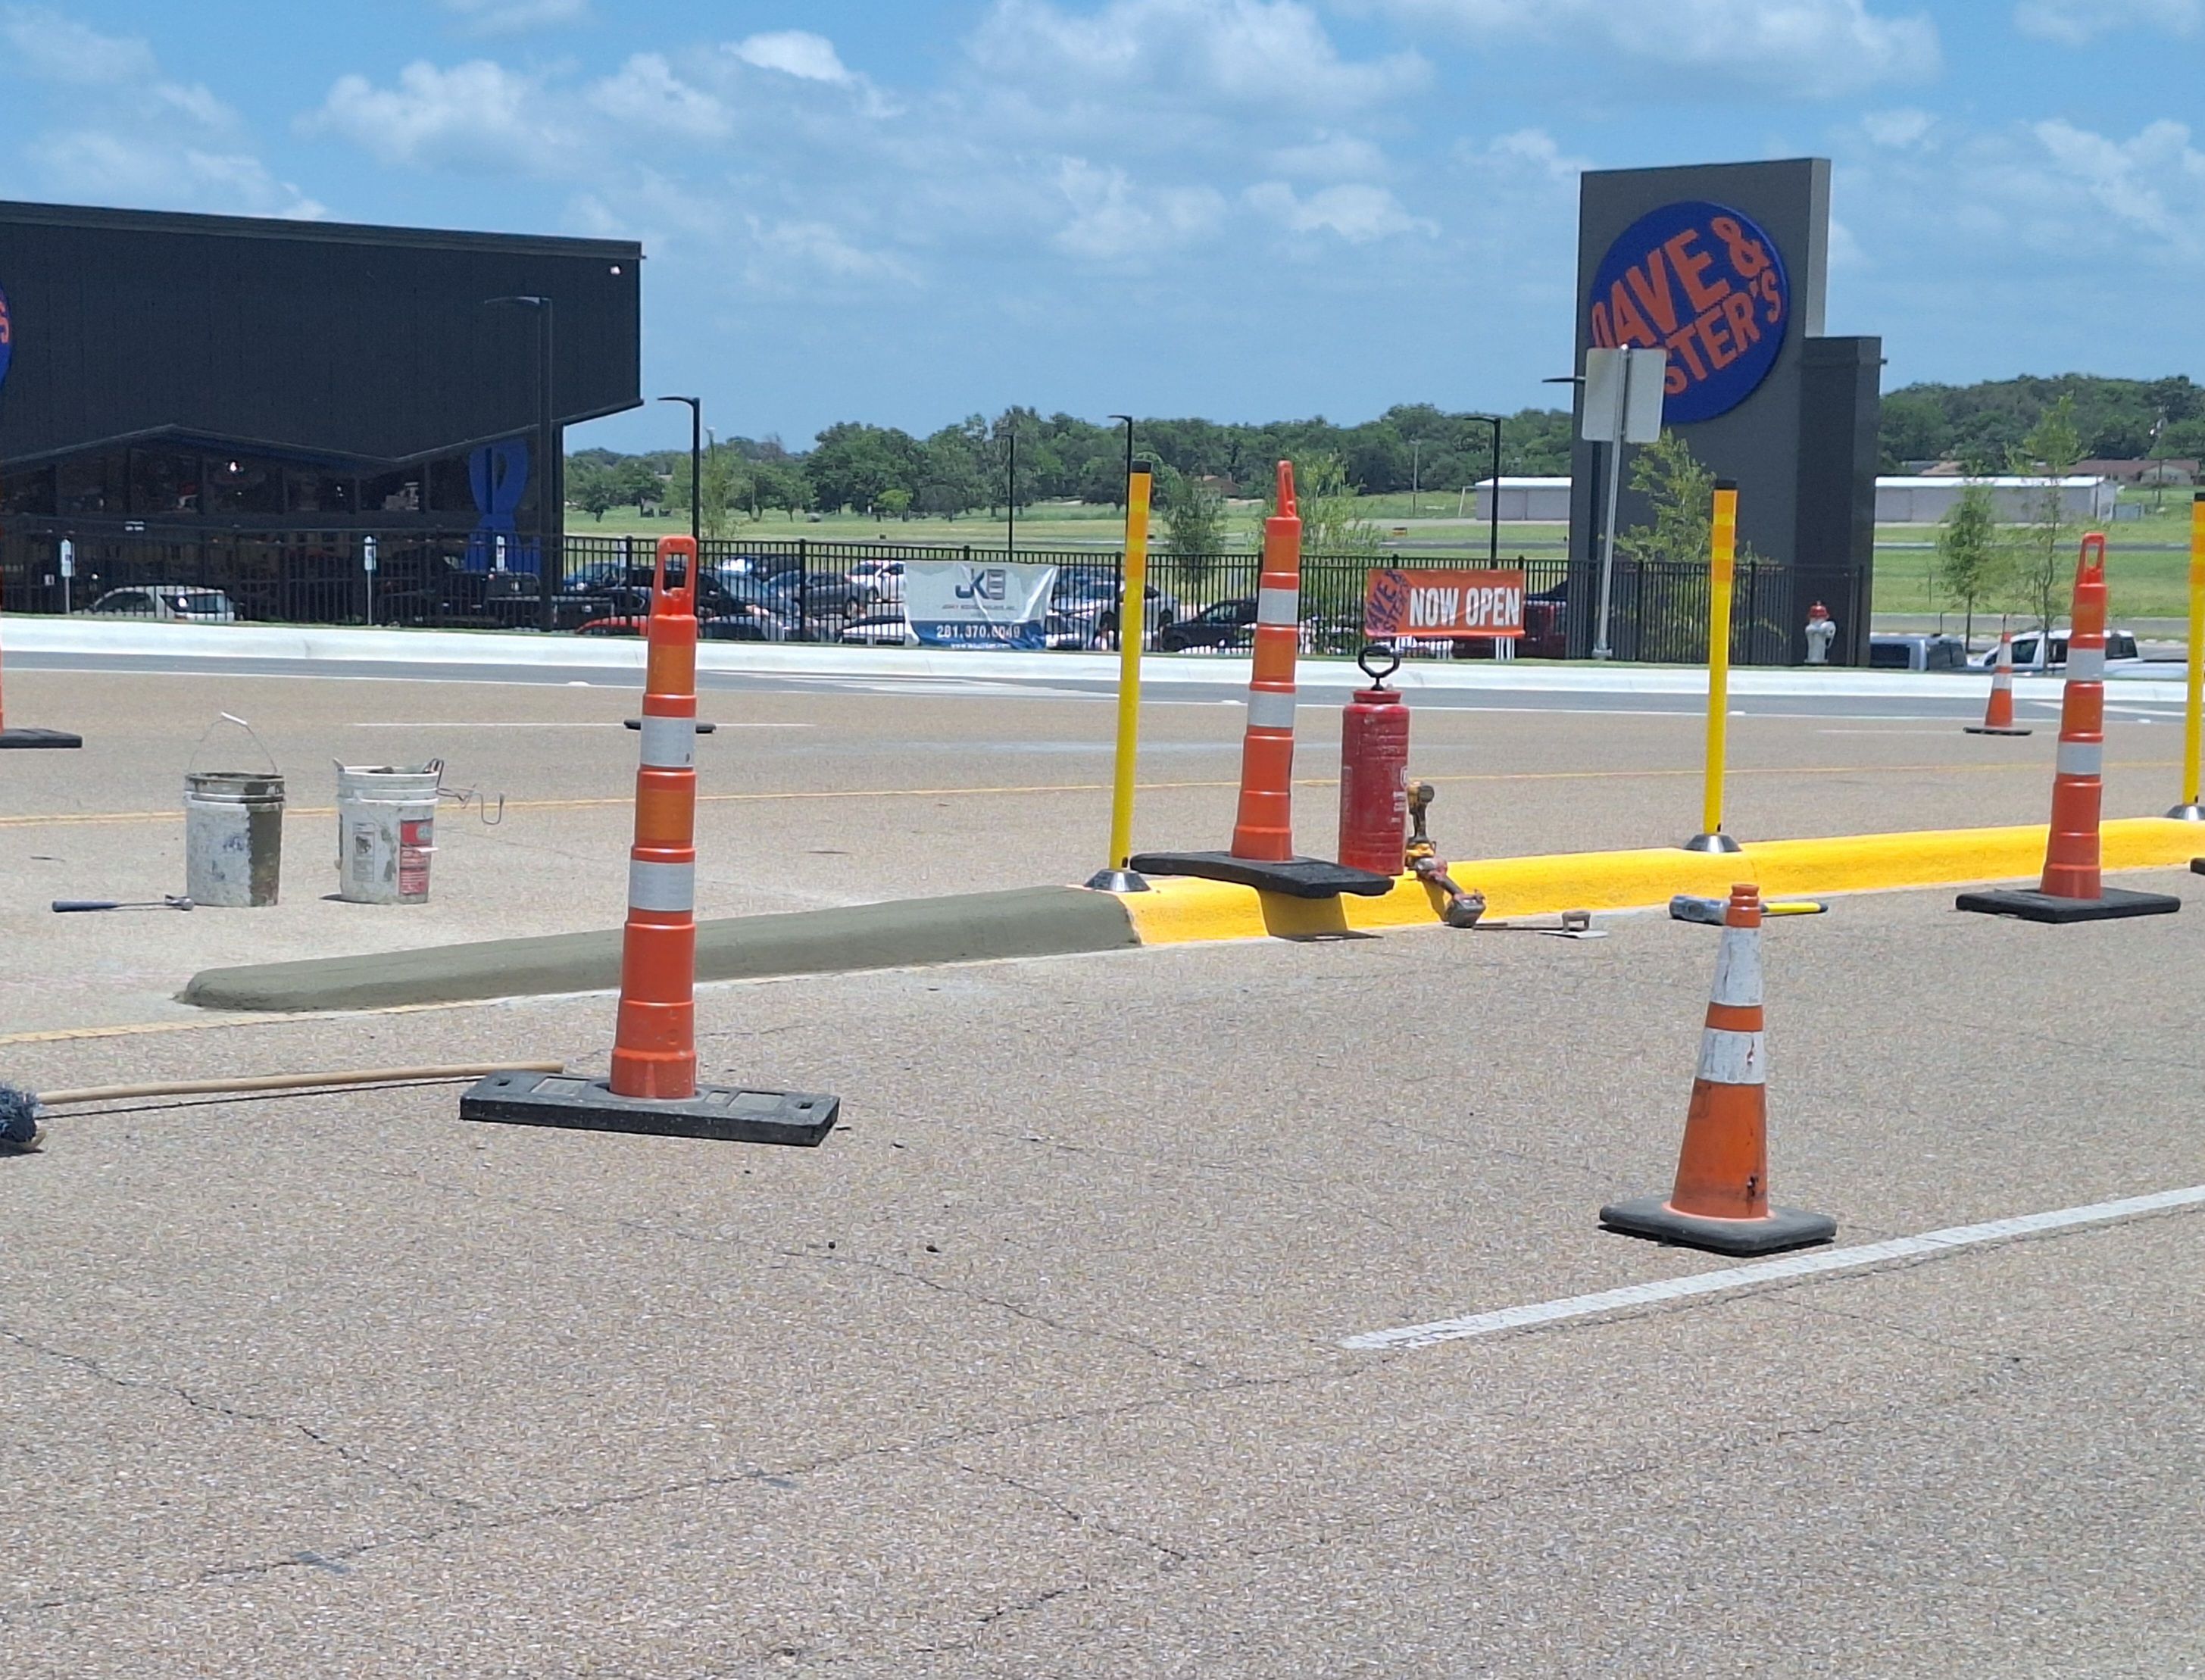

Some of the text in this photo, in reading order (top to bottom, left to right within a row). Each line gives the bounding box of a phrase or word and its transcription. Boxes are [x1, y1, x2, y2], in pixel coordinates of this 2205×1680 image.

[1711, 217, 1770, 278] &
[955, 568, 1006, 600] JKE
[1410, 587, 1519, 626] NOW OPEN
